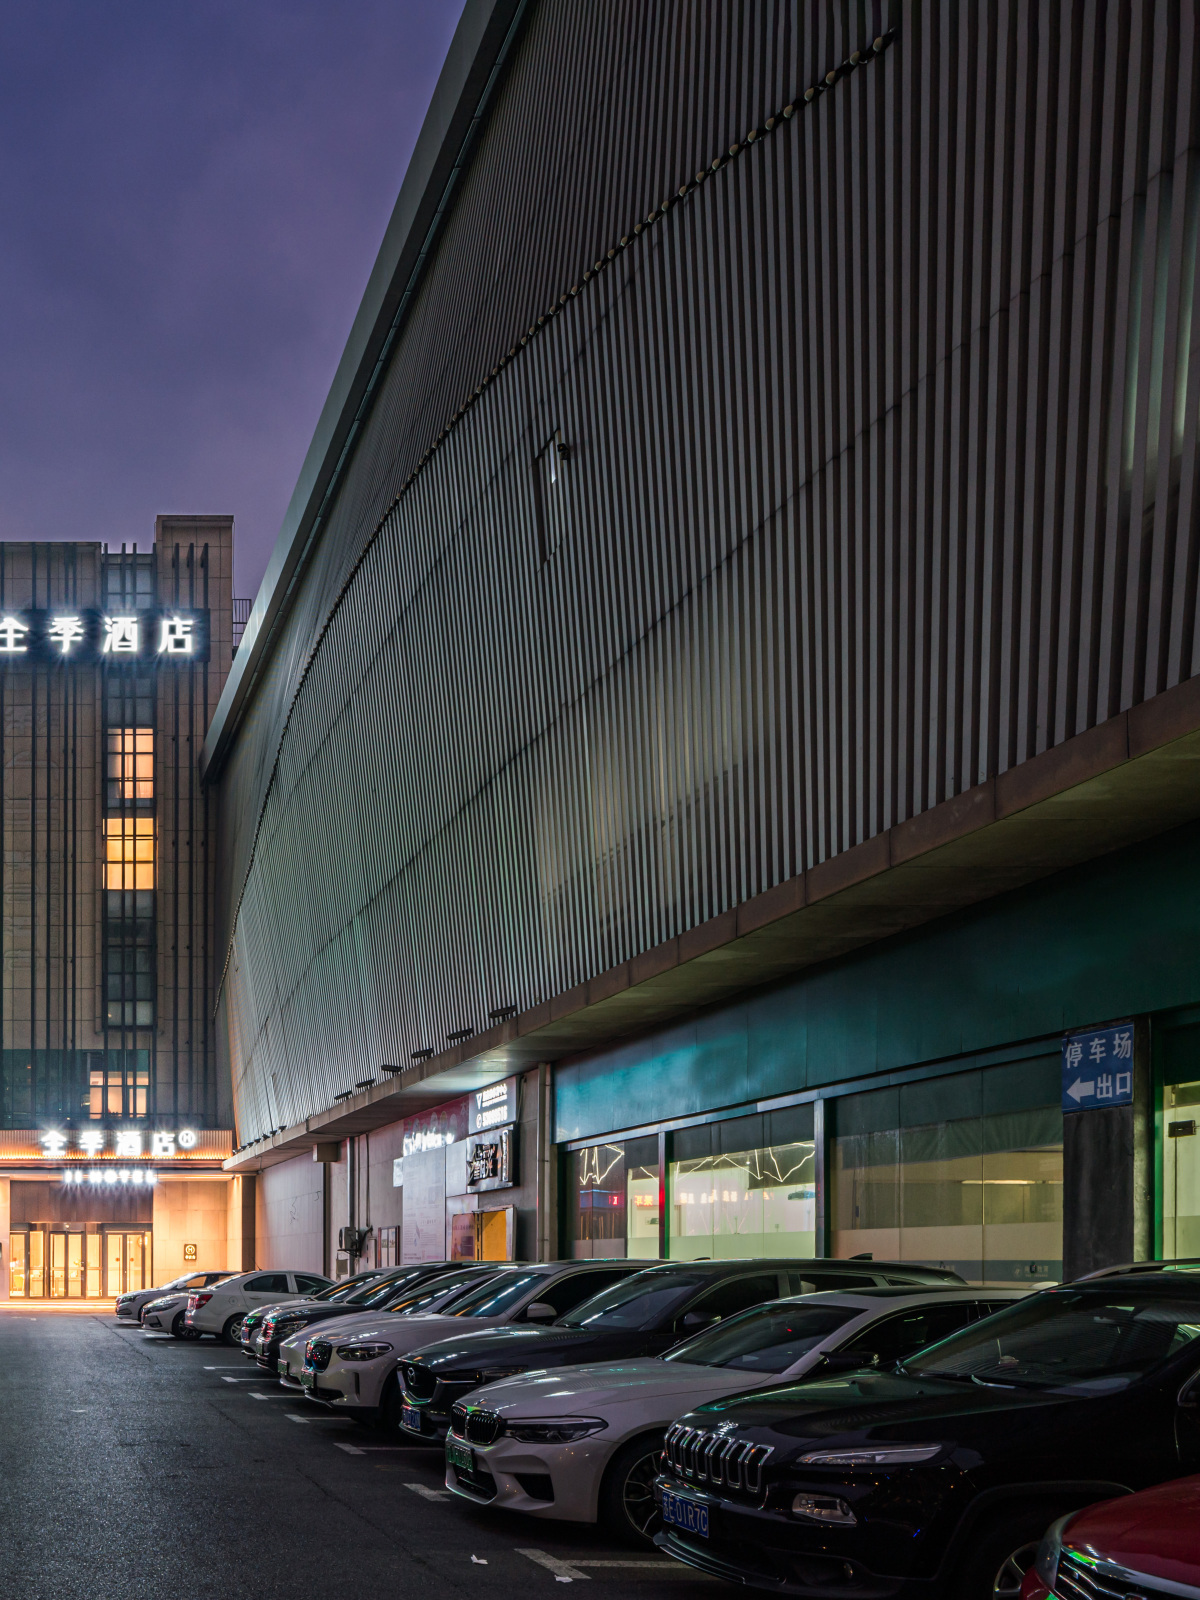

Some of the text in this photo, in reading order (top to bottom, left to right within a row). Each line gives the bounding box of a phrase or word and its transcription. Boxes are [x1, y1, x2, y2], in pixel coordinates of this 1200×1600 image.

[1065, 1031, 1132, 1069] 停车场
[1096, 1072, 1131, 1099] 出口
[41, 1130, 175, 1157] 全季酒店
[89, 1170, 157, 1185] HOTEL
